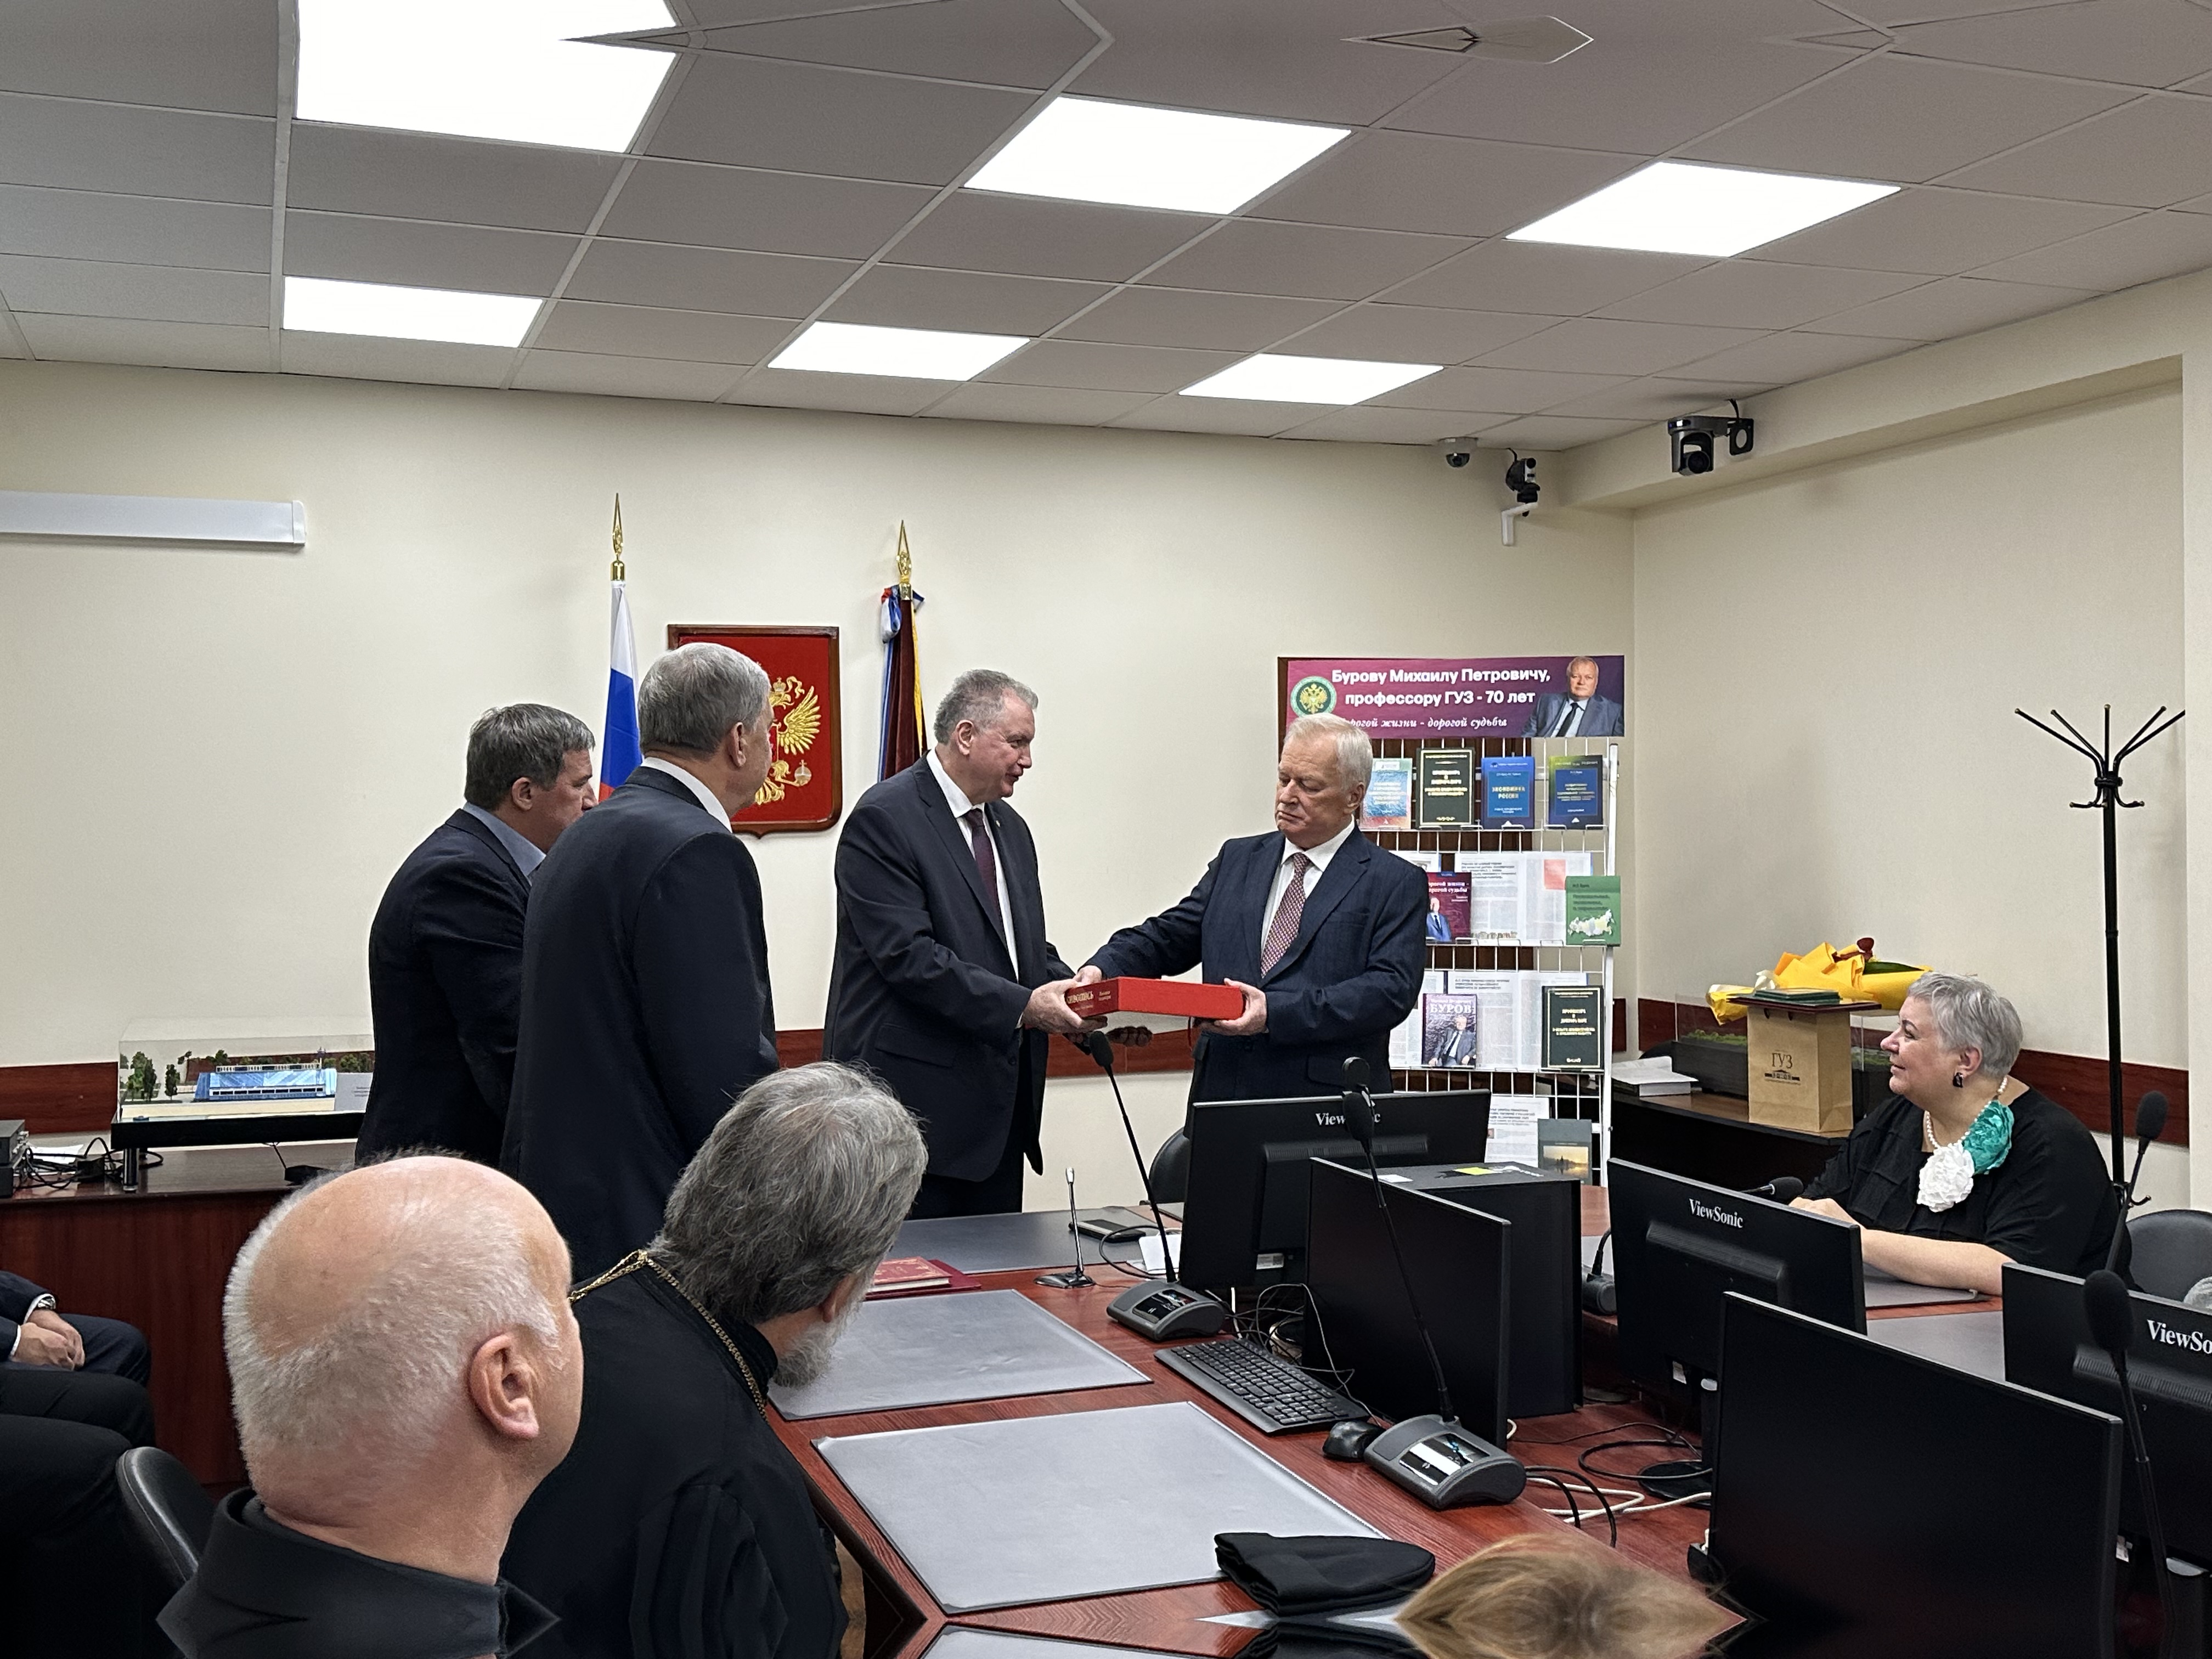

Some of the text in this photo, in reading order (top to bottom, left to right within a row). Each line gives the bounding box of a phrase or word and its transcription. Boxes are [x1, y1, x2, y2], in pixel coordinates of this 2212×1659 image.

[1331, 669, 1550, 685] Бурову Михаилу Петровичу,
[1345, 691, 1442, 707] профессору
[1444, 691, 1474, 704] ГУЗ
[1485, 690, 1504, 703] 70
[1507, 692, 1536, 703] лет
[1427, 717, 1468, 730] дорогой
[1470, 716, 1507, 729] судьбы
[1430, 1003, 1472, 1014] БУРОВ
[1771, 1052, 1793, 1069] ГУЗ
[1316, 1113, 1380, 1125] Viewc
[1689, 1198, 1743, 1228] ViewSonic
[2147, 1319, 2212, 1354] ViewSo
